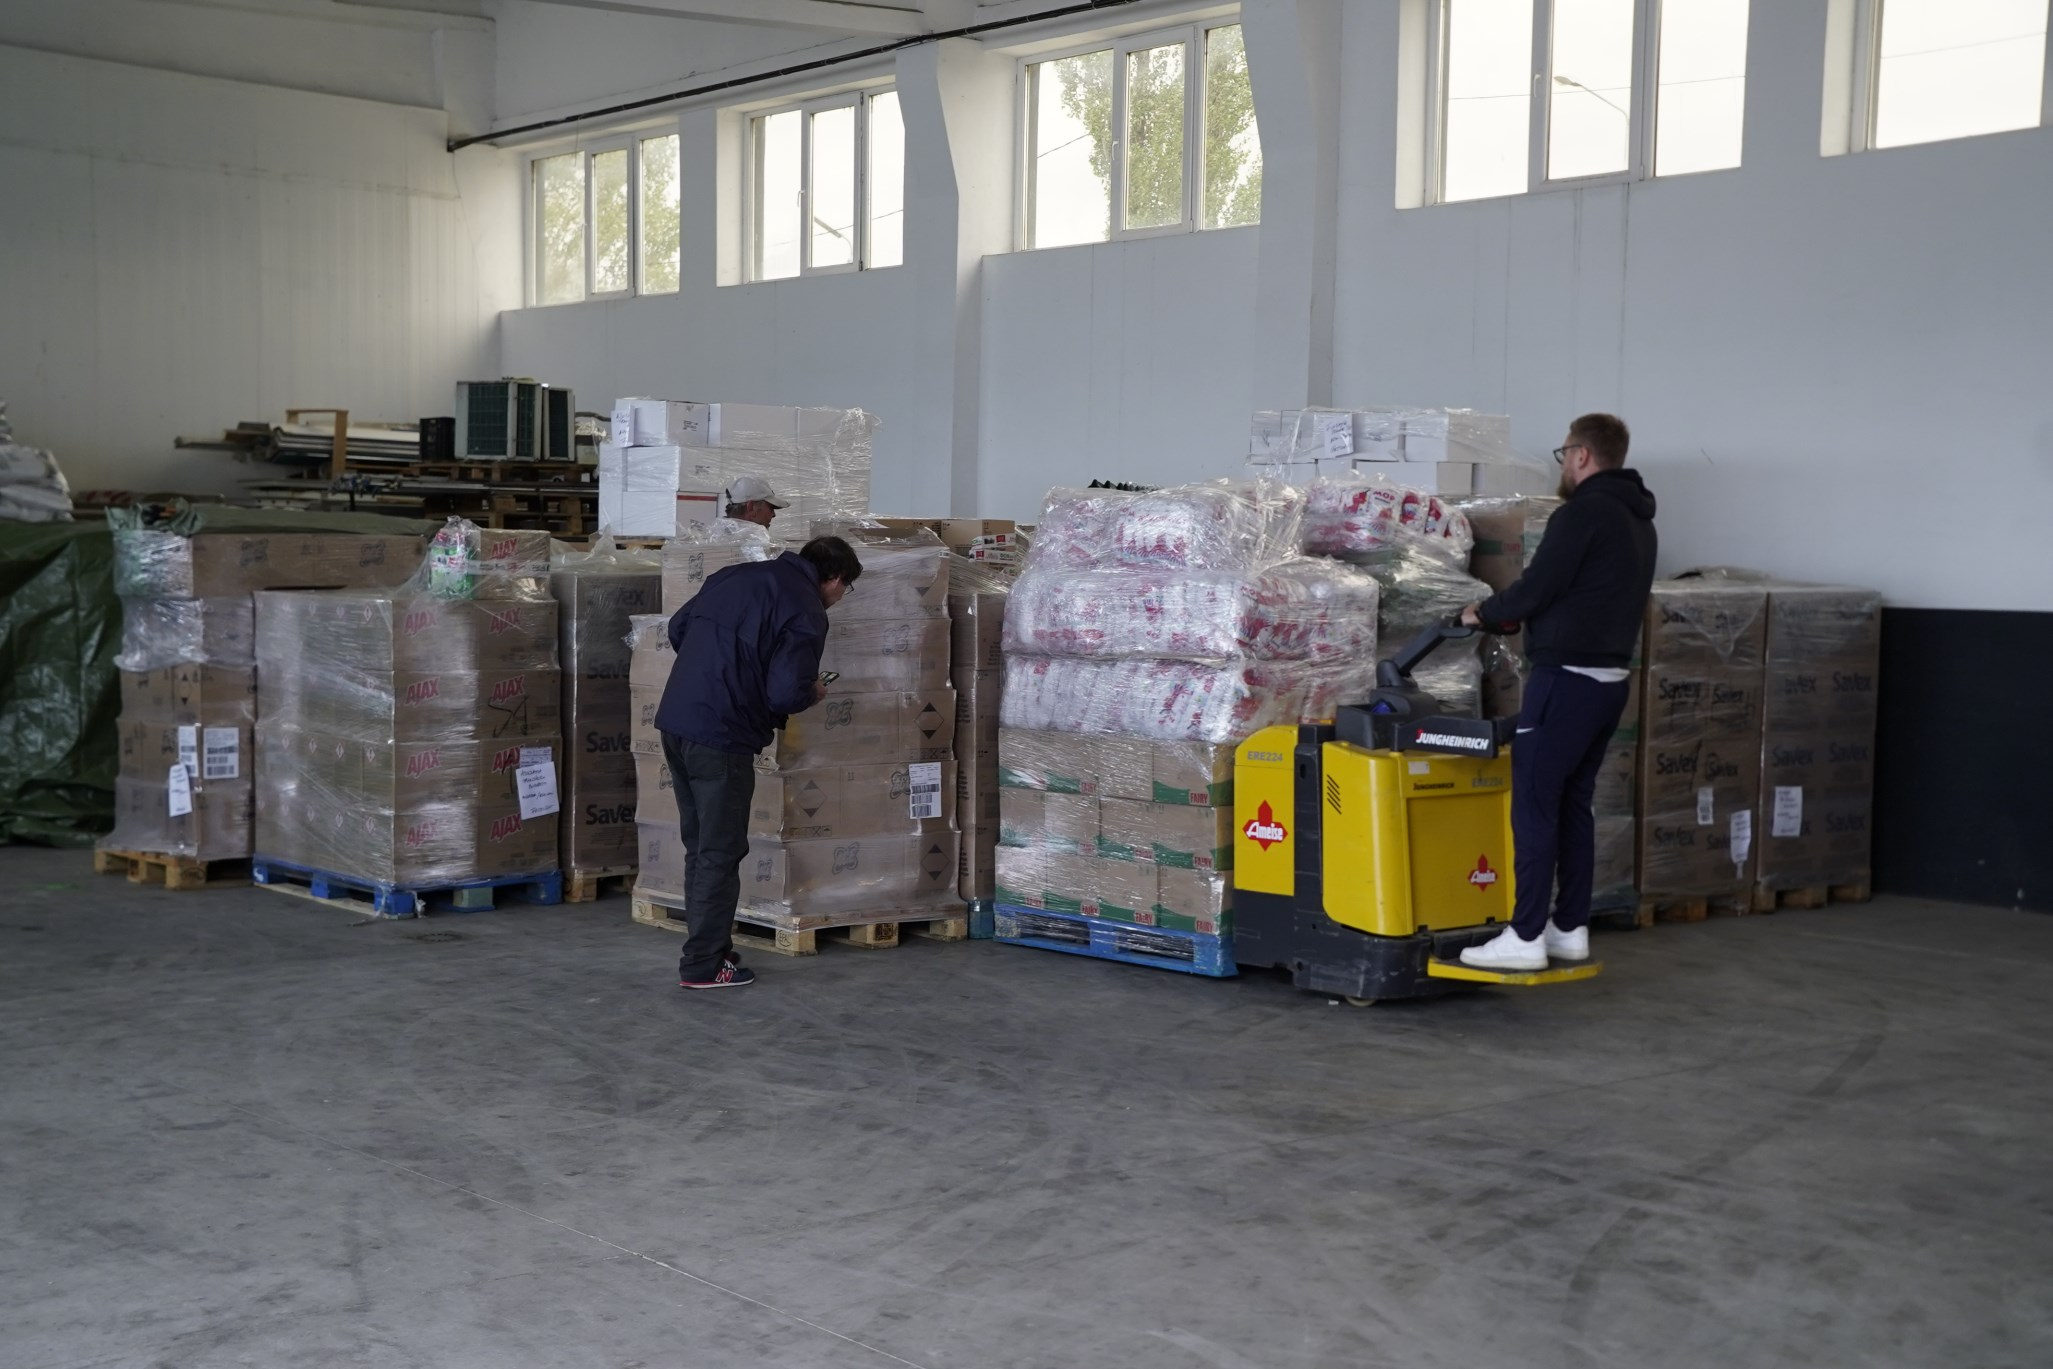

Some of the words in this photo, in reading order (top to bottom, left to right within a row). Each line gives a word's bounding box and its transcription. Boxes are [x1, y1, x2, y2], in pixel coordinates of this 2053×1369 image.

[404, 609, 437, 636] AJAX
[489, 608, 521, 634] AJAX
[405, 677, 440, 704] AJAX
[492, 676, 525, 704] AJAX
[1833, 671, 1871, 692] Savex
[587, 731, 630, 753] Save
[1416, 730, 1489, 750] JUNGHEINRICH
[406, 748, 441, 777] AJAX
[1247, 751, 1283, 763] ERE224
[1657, 753, 1697, 774] Savex
[1772, 745, 1814, 767] Savex
[1829, 743, 1868, 762] Savex
[1190, 792, 1208, 804] FAIRY
[491, 814, 522, 842] AJAX
[1246, 821, 1284, 842] Ameise
[1825, 811, 1865, 833] Savex
[1196, 920, 1213, 933] FAIRY
